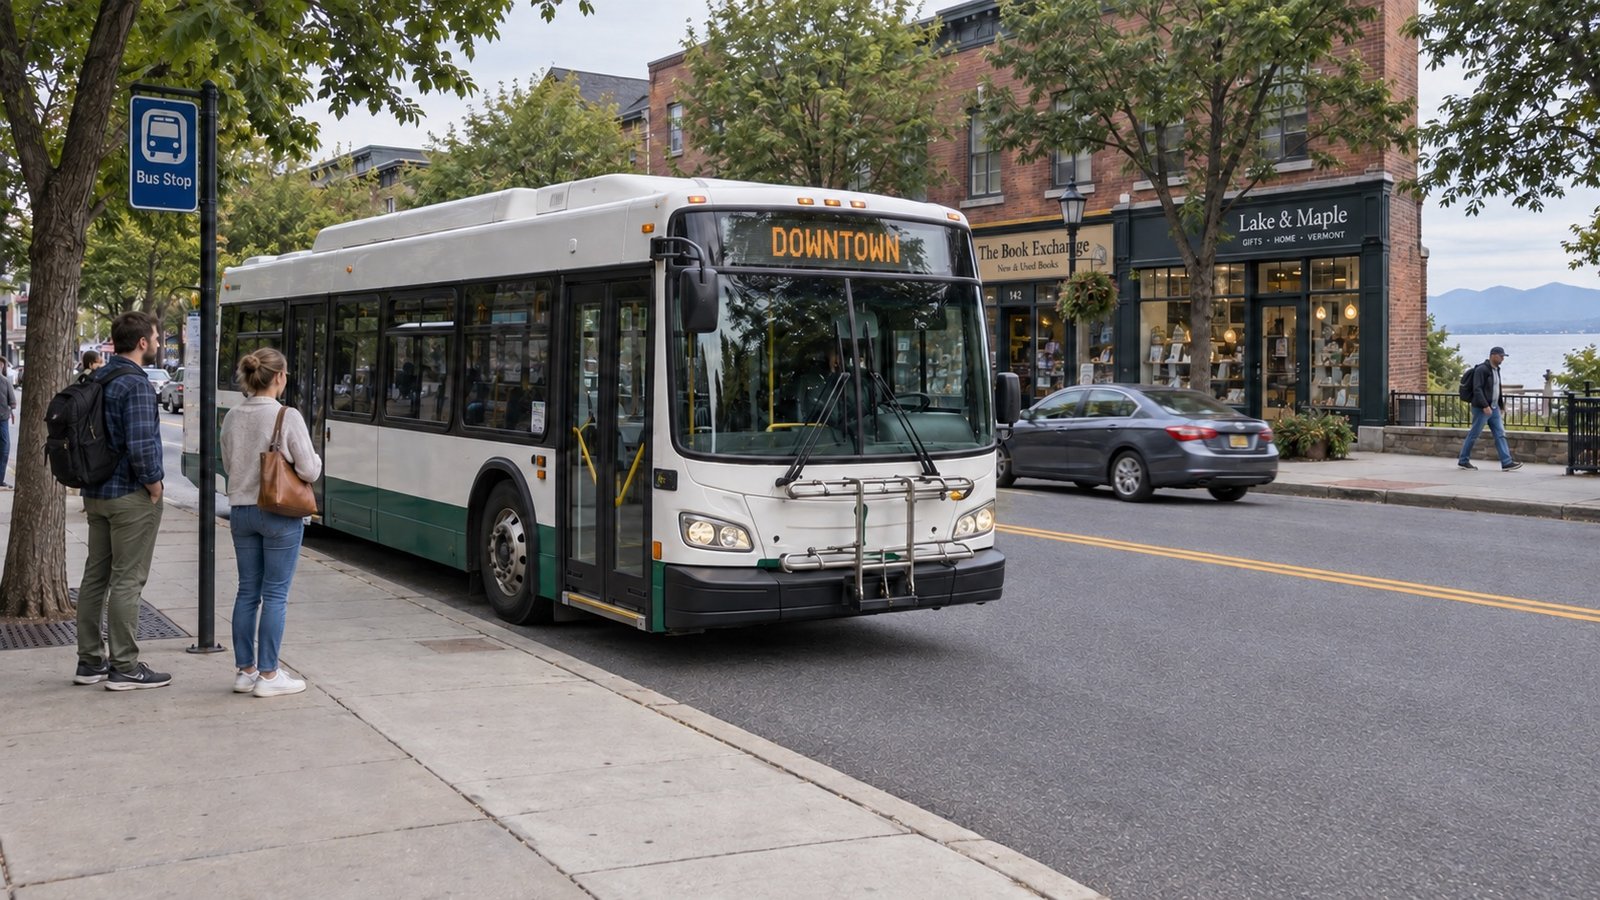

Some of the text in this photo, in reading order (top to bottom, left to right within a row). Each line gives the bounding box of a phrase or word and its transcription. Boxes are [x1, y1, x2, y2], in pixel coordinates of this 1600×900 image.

[136, 170, 192, 190] Bus Stop
[1239, 204, 1348, 232] Lake & Maple
[772, 226, 900, 264] DOWNTOWN
[1242, 231, 1345, 246] GIFTS HOME VERMONT
[978, 245, 998, 260] The
[1001, 241, 1029, 259] Book
[997, 264, 1011, 272] New
[1020, 261, 1037, 271] Used
[1038, 260, 1059, 269] Books
[1009, 290, 1022, 300] 142
